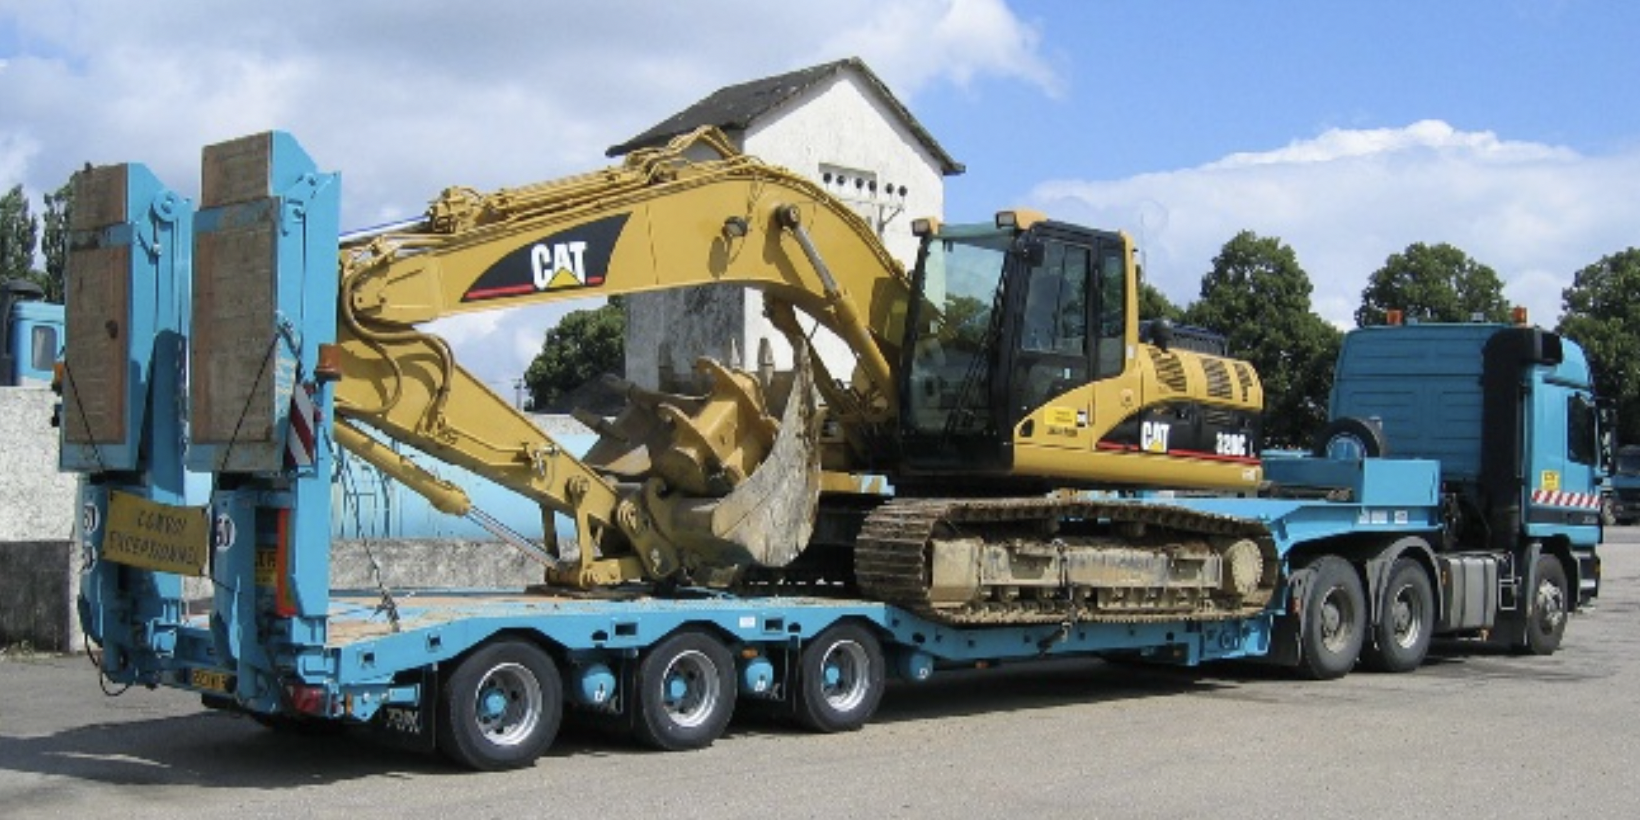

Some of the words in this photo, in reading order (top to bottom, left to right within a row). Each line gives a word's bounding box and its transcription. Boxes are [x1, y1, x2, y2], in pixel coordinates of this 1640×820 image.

[531, 241, 587, 291] CAT
[1142, 421, 1170, 453] CAT
[137, 509, 188, 534] CONVOI
[109, 530, 200, 566] EXCEPTIONNEL
